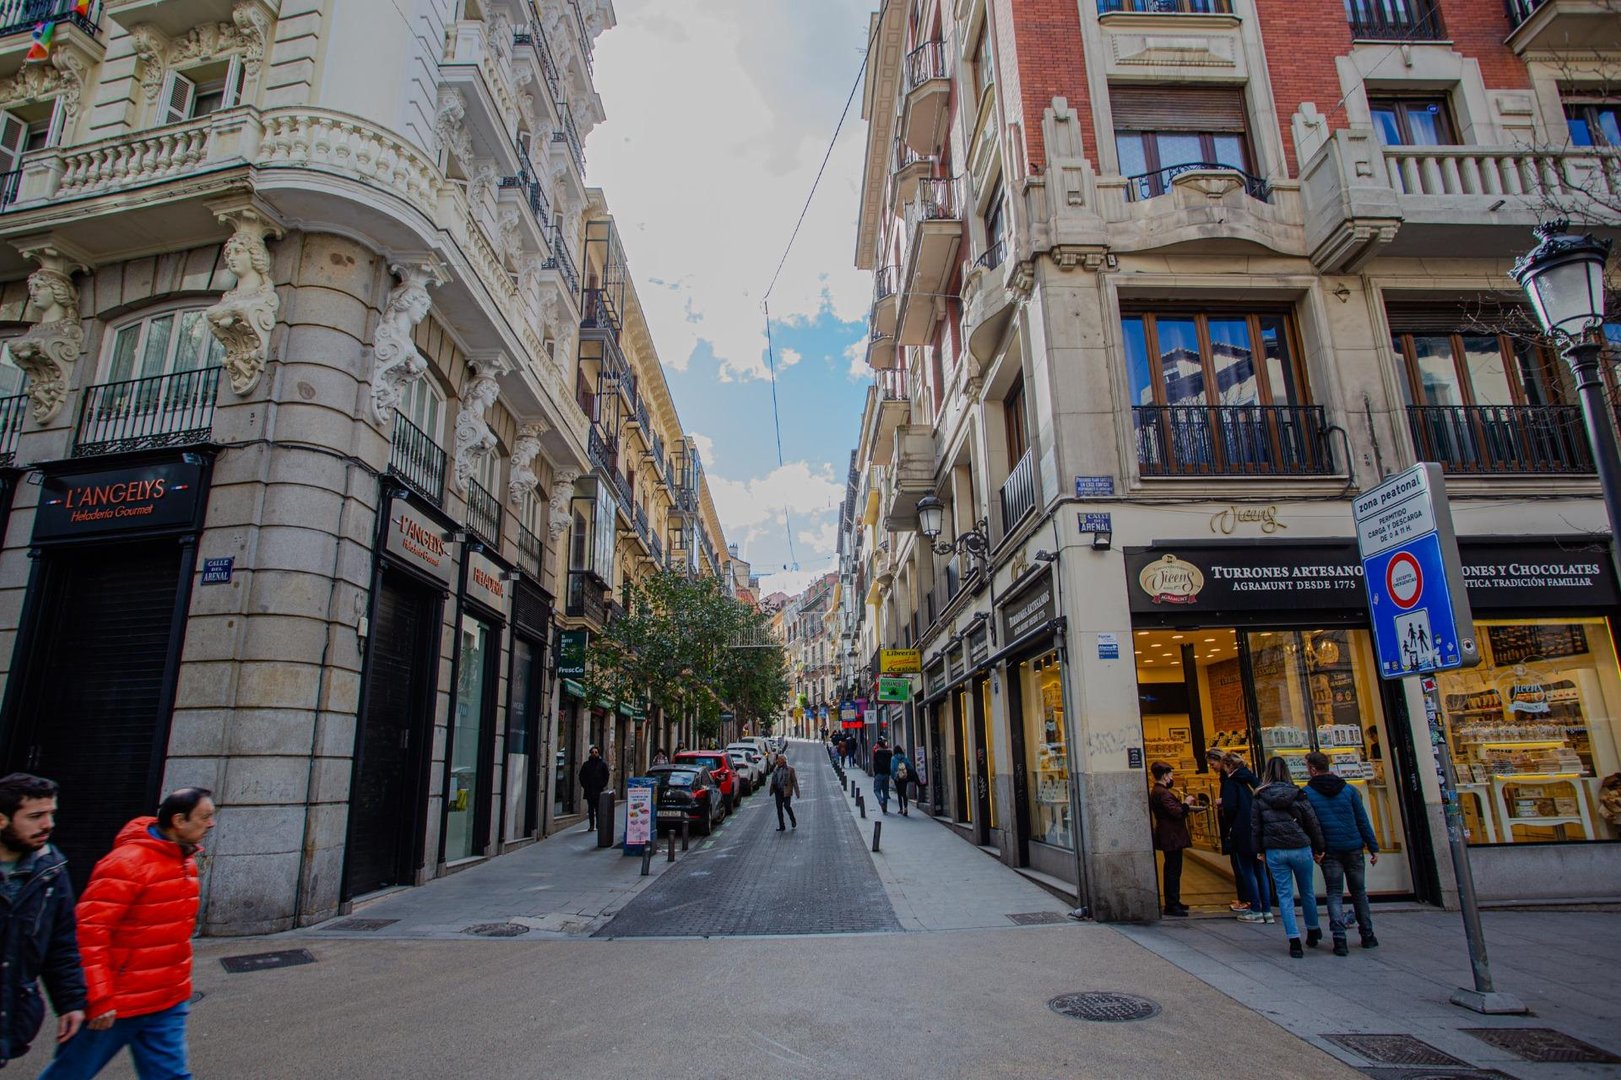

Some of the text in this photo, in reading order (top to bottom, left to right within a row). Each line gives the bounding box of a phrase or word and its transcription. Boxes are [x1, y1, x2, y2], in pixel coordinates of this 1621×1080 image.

[65, 479, 165, 509] L'ANGELYS
[1359, 475, 1420, 513] zona peatonal
[115, 504, 153, 517] Gourmet
[1379, 508, 1407, 525] PERMITIDO
[1081, 523, 1110, 531] ARENAL
[1368, 526, 1386, 539] CARGA
[1392, 510, 1422, 528] DESCARGA
[1380, 534, 1387, 542] DE
[1211, 565, 1364, 579] TURRONES ARTESANO
[1461, 563, 1600, 576] ONES Y CHOCOLATES
[204, 572, 229, 581] ARENAL
[1492, 577, 1546, 587] TRADICIÓN
[1547, 577, 1593, 586] FAMILIAR
[1233, 580, 1356, 591] AGRAMUNT DESDE 1775
